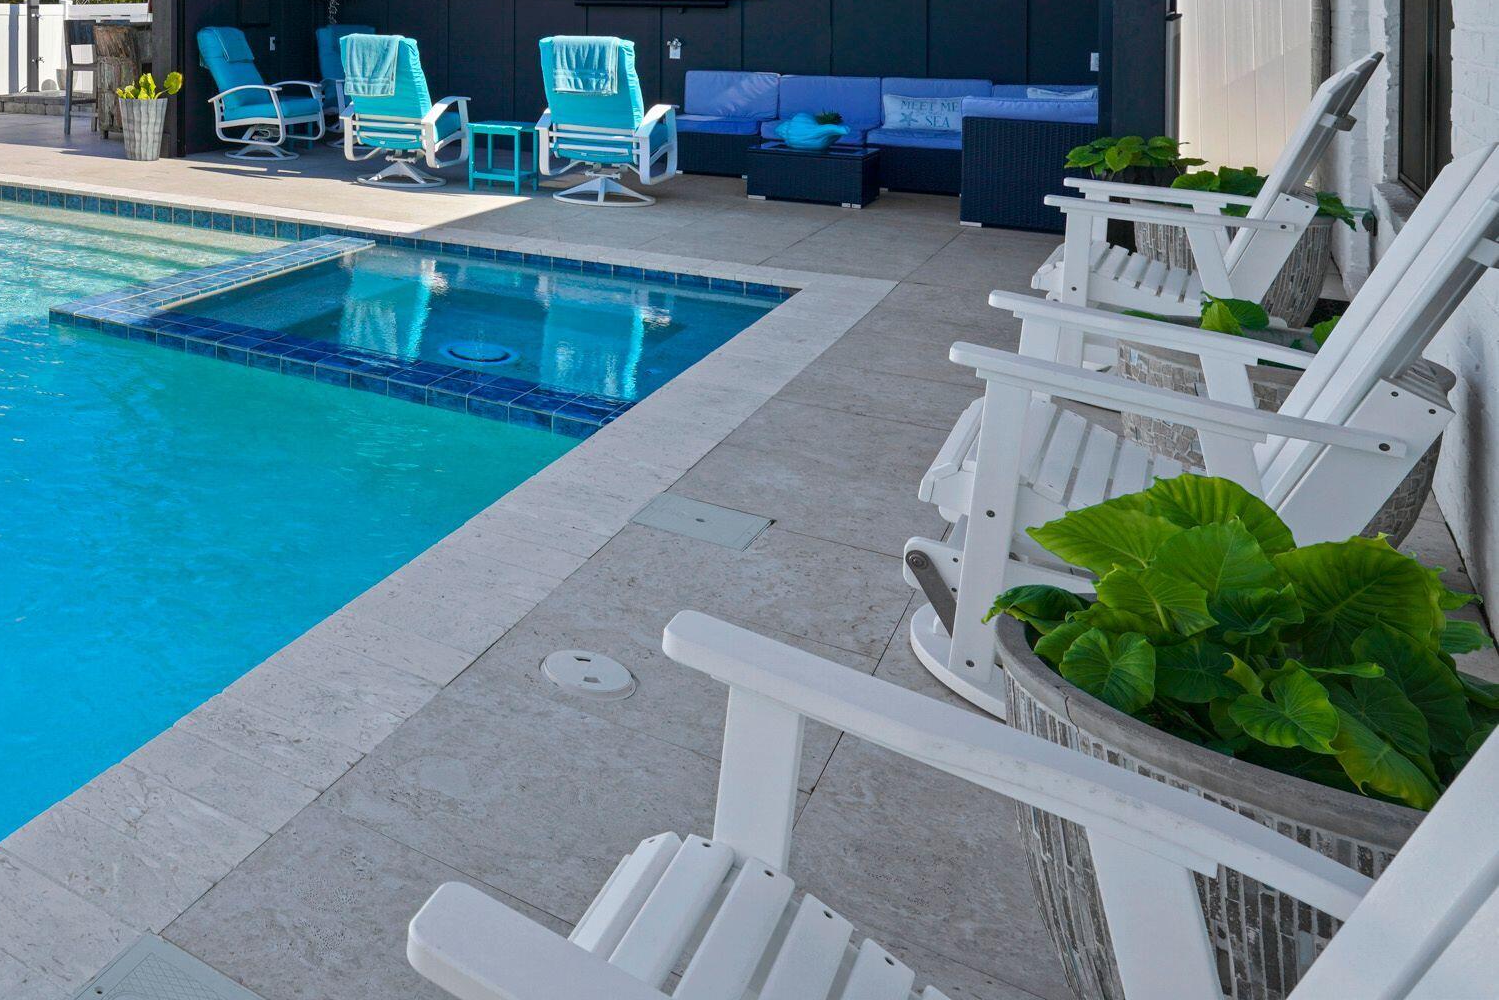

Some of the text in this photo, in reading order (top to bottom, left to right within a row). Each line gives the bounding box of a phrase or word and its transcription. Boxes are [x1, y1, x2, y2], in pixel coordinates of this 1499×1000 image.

[900, 100, 959, 112] MEET ME
[925, 115, 950, 128] SEA
